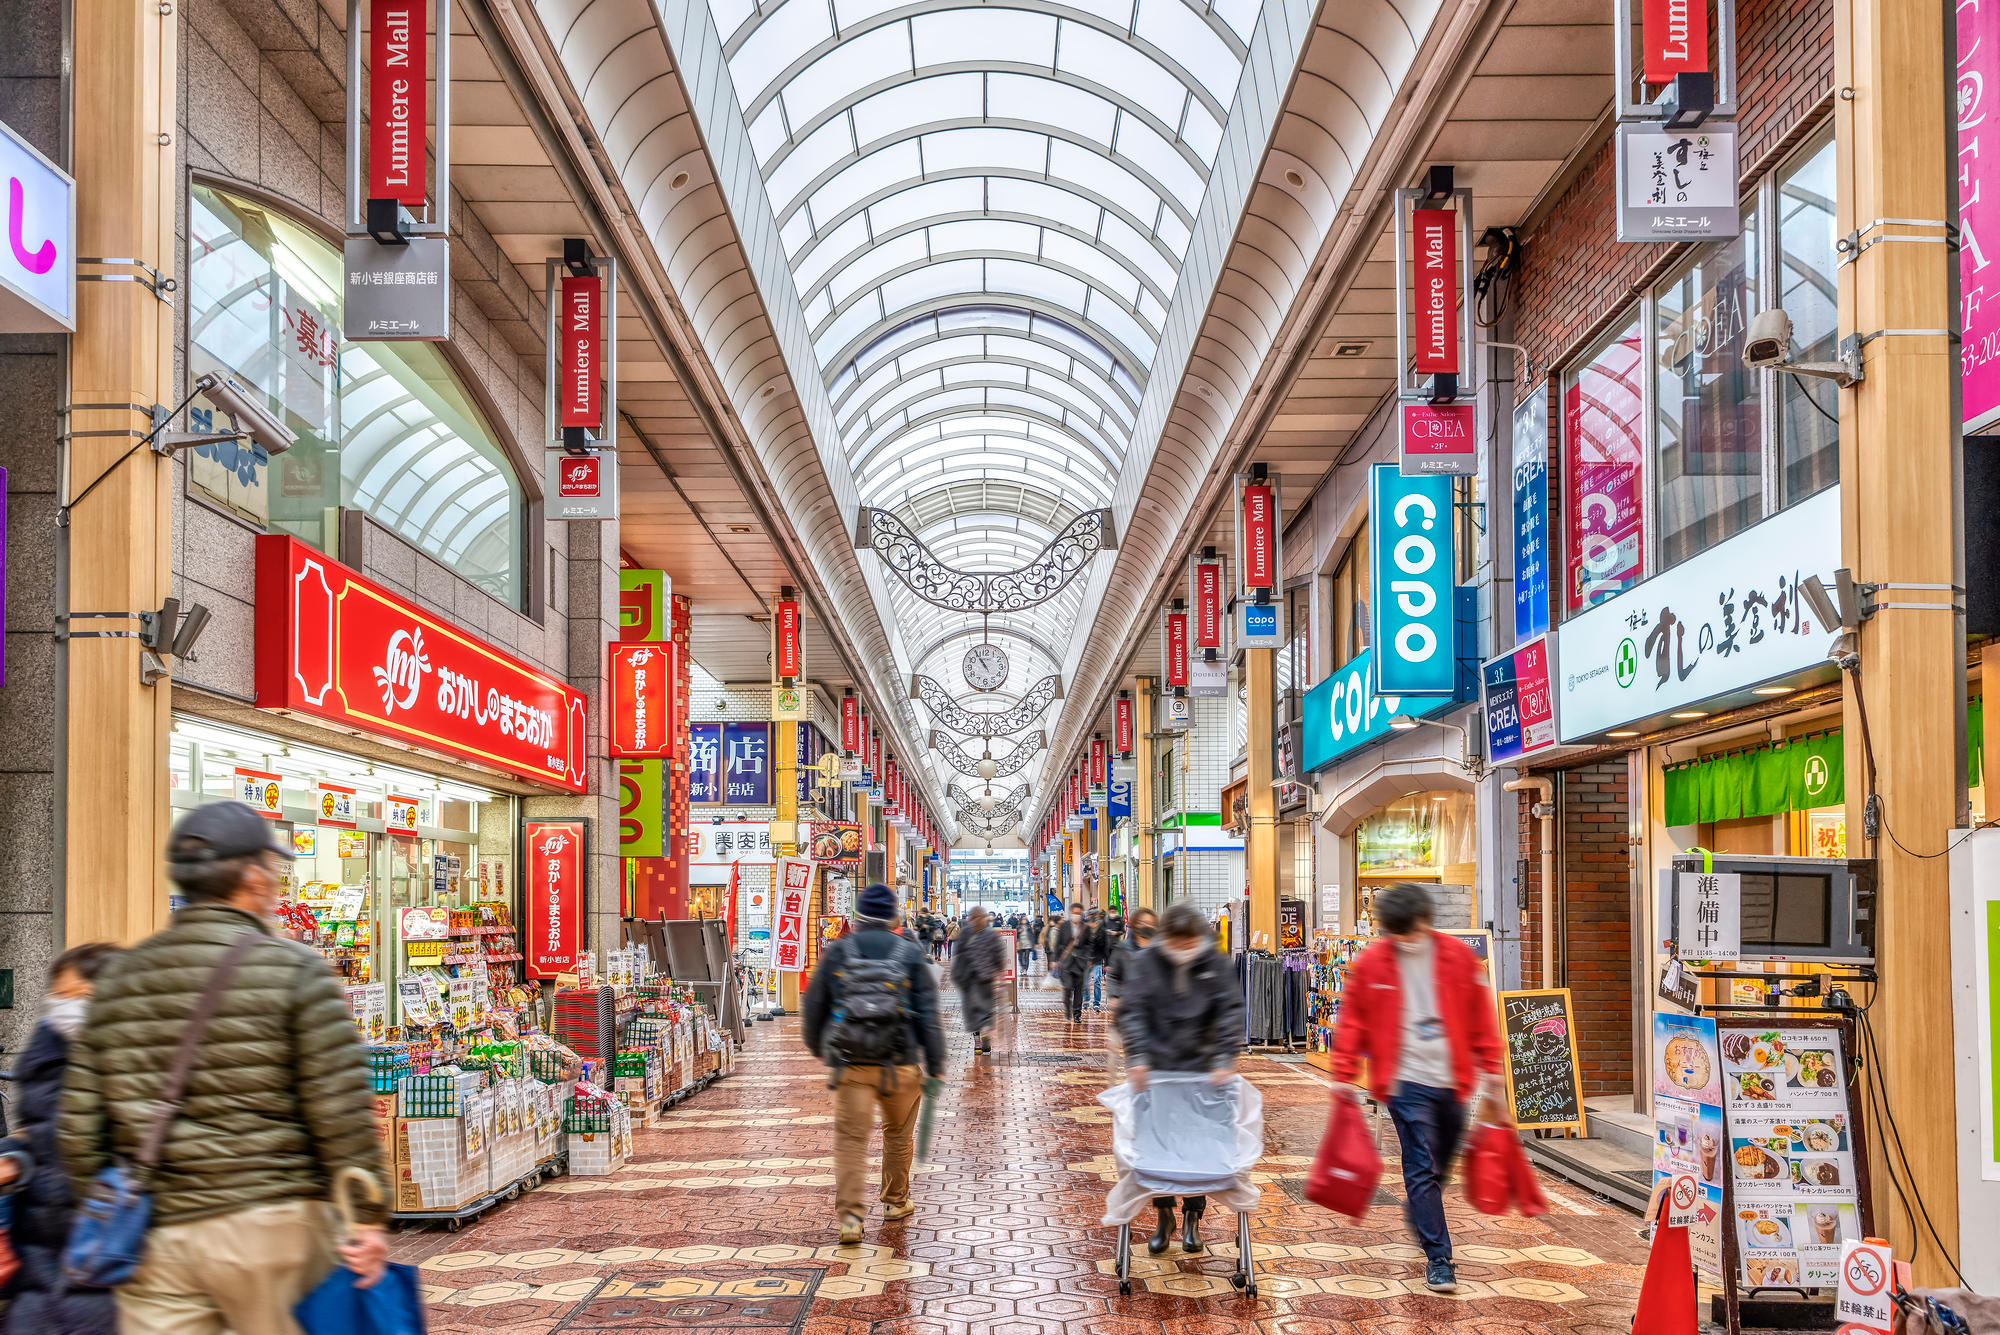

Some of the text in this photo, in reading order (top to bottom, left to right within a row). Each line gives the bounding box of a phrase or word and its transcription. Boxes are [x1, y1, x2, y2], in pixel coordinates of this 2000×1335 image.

[385, 9, 409, 187] Lumiere Mall
[1667, 138, 1693, 202] すしの
[1652, 216, 1711, 227] ルミエール
[350, 271, 438, 286] 新小岩銀座商店街
[1425, 225, 1445, 359] Lumiere Mall
[368, 320, 419, 330] ルミエール
[572, 291, 590, 414] Lumiere Mall
[1412, 420, 1465, 438] CREA
[1521, 403, 1537, 434] 3F
[1420, 461, 1460, 469] ルミエール
[1515, 455, 1544, 492] CREA
[1253, 495, 1265, 578] Lumiere Mall
[1391, 493, 1437, 663] copo
[1203, 572, 1214, 640] Lumiere Mall
[784, 608, 793, 670] Lumiere Mall
[1173, 620, 1183, 679] Lumiere Mall
[1494, 666, 1504, 684] 3F
[1526, 649, 1537, 668] 2F
[437, 665, 553, 750] おかしのまちおか
[634, 669, 647, 750] おかしのまちおか
[1330, 661, 1400, 742] cop
[1488, 704, 1519, 733] CREA
[1520, 686, 1552, 720] CREA
[546, 754, 565, 773] 新小岩店
[689, 736, 765, 775] 商店
[690, 782, 755, 797] 新小岩店
[1818, 828, 1838, 848] 祝
[547, 858, 561, 952] おかしのまちおか
[777, 862, 809, 966] 新台入替
[1697, 874, 1719, 948] 準備中
[539, 956, 570, 964] 新小岩店
[1669, 1215, 1696, 1225] 駐輪禁止
[1840, 1300, 1887, 1321] 駐輪禁止
